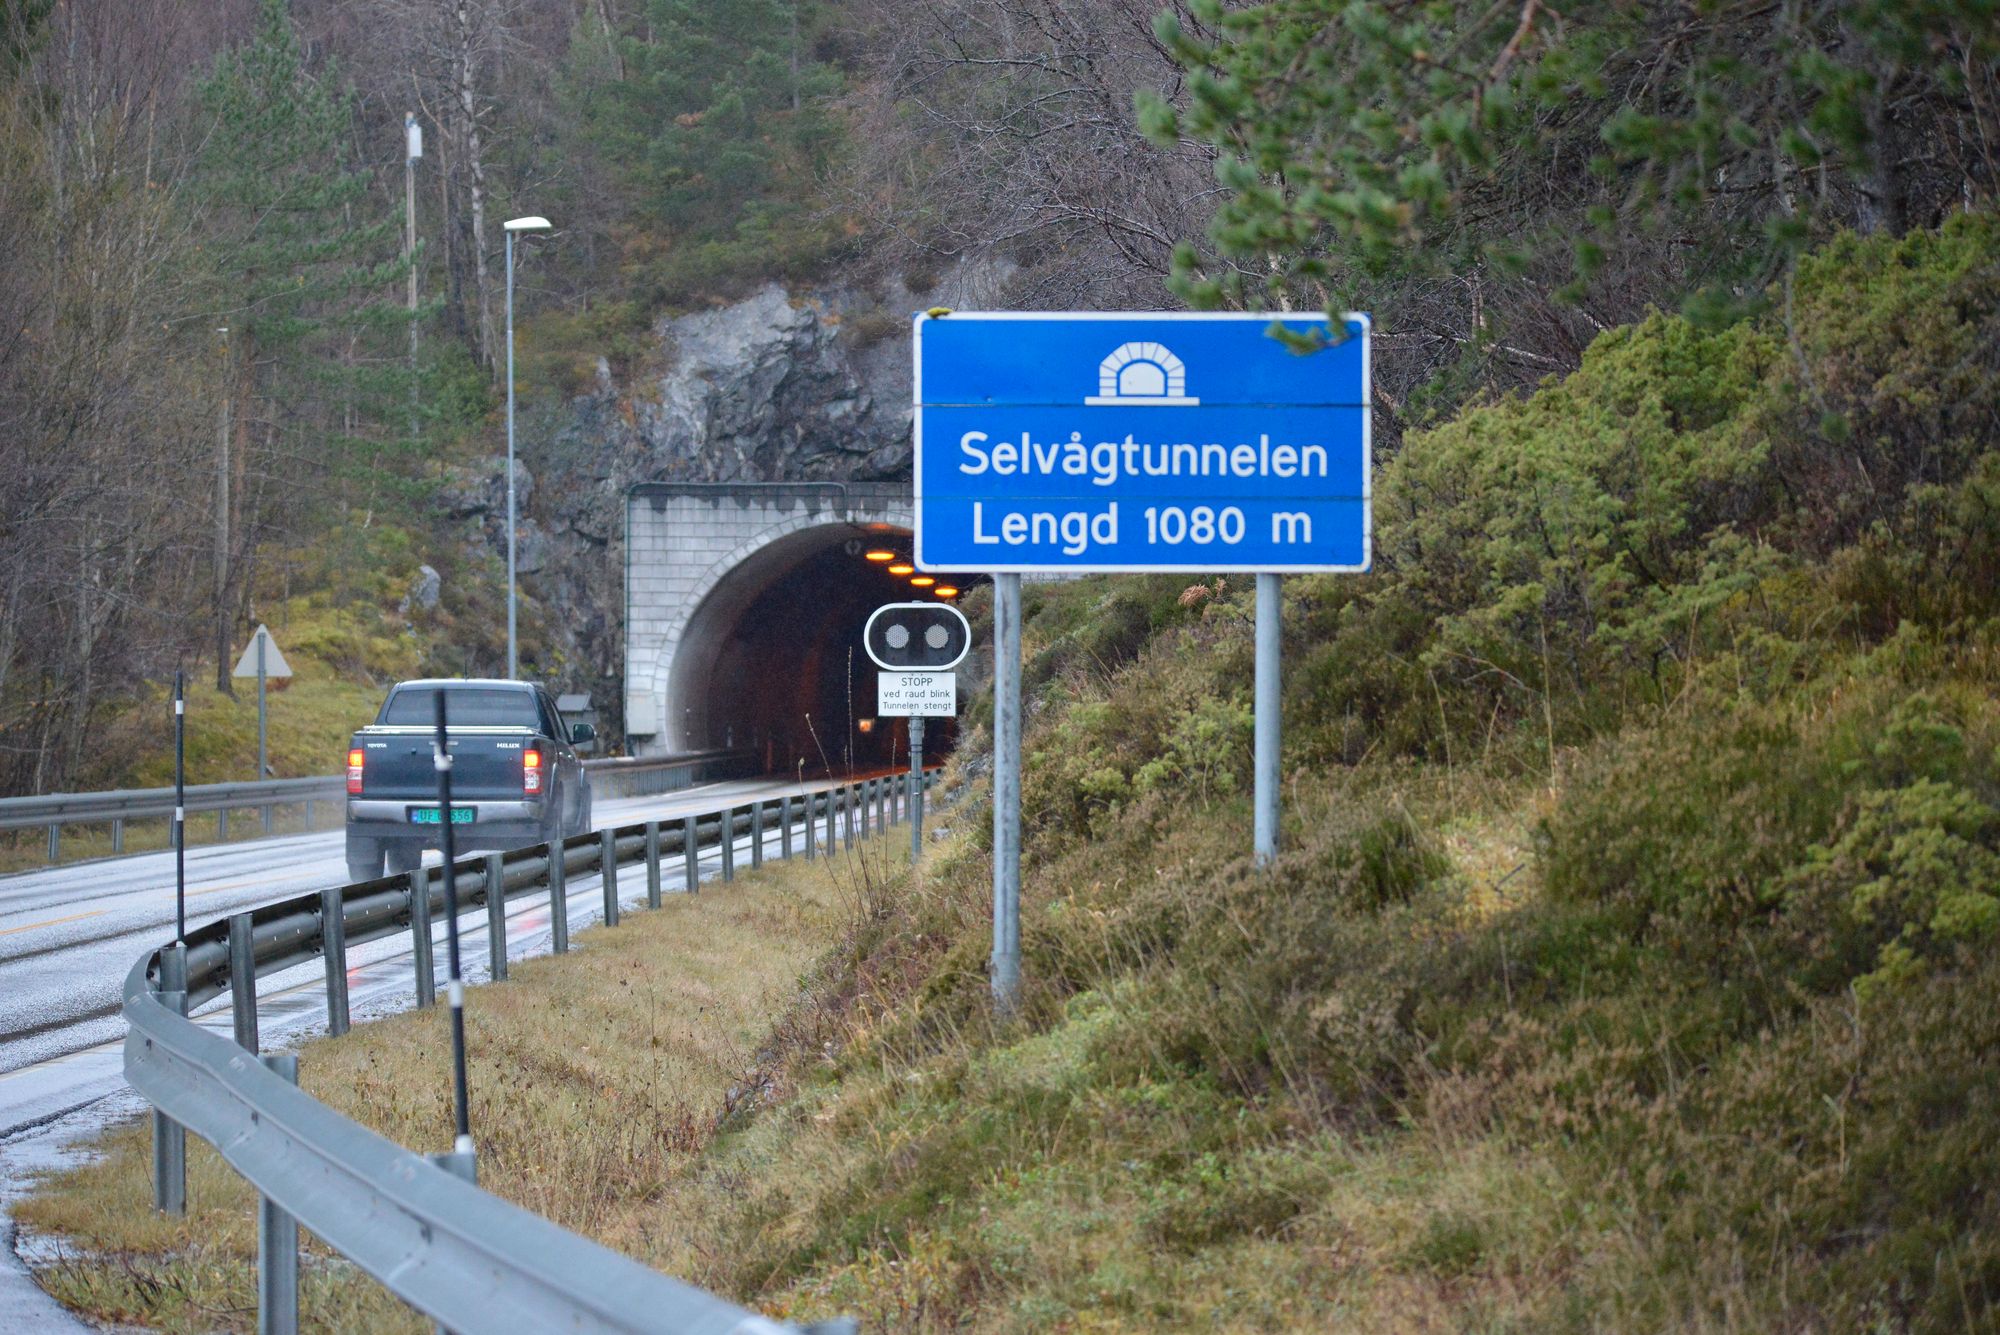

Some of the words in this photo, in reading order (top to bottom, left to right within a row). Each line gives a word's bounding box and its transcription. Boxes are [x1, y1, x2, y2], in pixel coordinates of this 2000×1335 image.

[959, 431, 1328, 486] Selvågtunnelen
[973, 501, 1119, 556] Lengd
[1144, 506, 1246, 545] 1080
[1271, 510, 1313, 544] m
[901, 677, 932, 686] STOPP
[884, 690, 900, 698] ved
[905, 690, 926, 698] raud
[930, 690, 951, 698] blink
[924, 702, 951, 711] stengt
